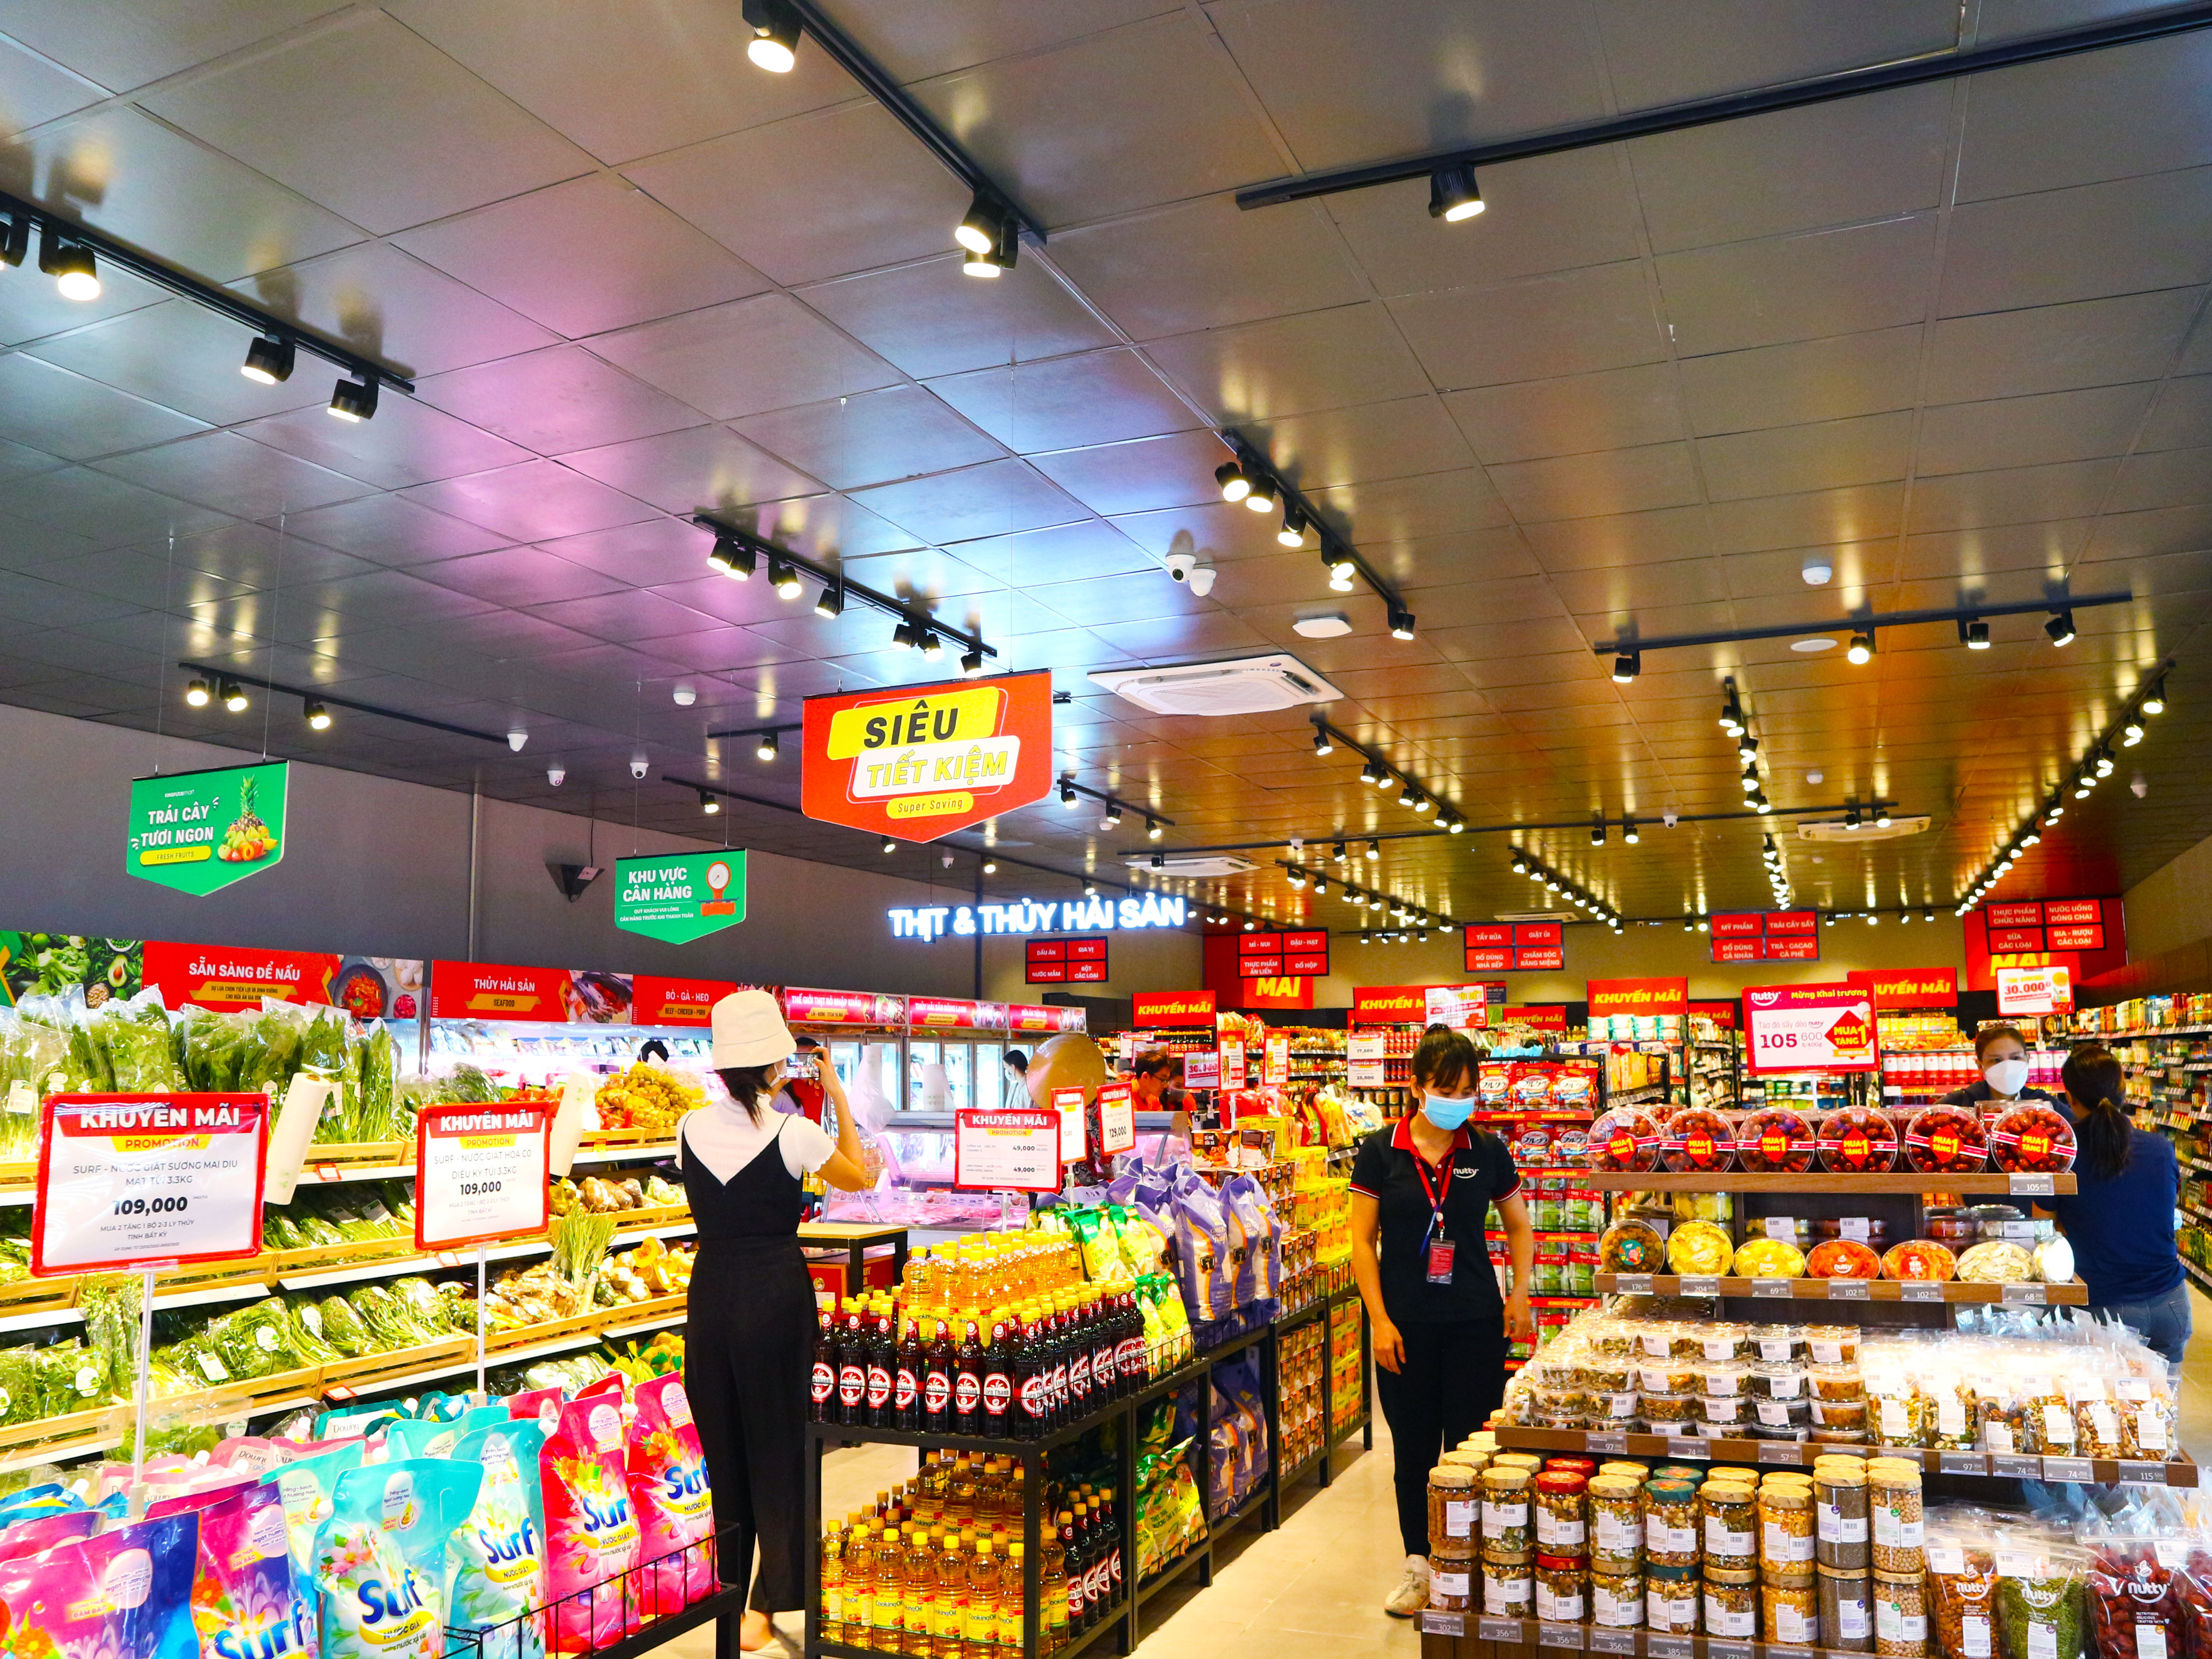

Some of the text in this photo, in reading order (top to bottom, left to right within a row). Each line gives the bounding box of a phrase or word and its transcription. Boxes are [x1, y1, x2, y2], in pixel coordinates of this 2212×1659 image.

[864, 699, 958, 748] SIÊU
[867, 745, 1008, 788] TIẾT KIỆM
[148, 801, 210, 825] TRÁI CÂY
[898, 798, 962, 814] Super Saving
[141, 827, 214, 847] TƯƠI NGON
[157, 851, 194, 861] FRESH FRUITS
[629, 866, 687, 885] KHU VỰC
[623, 882, 692, 902] CÂN HÀNG
[2072, 903, 2093, 912] UỐNG
[889, 891, 1184, 942] THỊT & THỦY HẢI SẢN
[2072, 929, 2092, 938] RƯỢU
[2075, 937, 2091, 946] LOẠI
[189, 956, 301, 980] SẴN SÀNG ĐỂ NẤU
[474, 978, 535, 992] THỦY HẢI SẢN
[666, 988, 675, 1000] BÒ
[681, 989, 690, 1000] GÀ
[696, 993, 709, 1001] HEO
[1595, 989, 1681, 1004] KHUYẾN MÃI
[1751, 992, 1779, 1006] nutty
[1837, 989, 1868, 998] trương
[493, 998, 515, 1008] SEAFOOD
[1138, 1001, 1211, 1014] KHUYẾN MÃI
[1360, 996, 1412, 1009] KHUYẾN
[1761, 1033, 1797, 1048] 105
[1834, 1025, 1866, 1045] MUA 1
[1835, 1036, 1858, 1046] TẶNG
[80, 1102, 240, 1129] KHUYẾN MÃI
[441, 1109, 533, 1132] KHUYẾN MÃI
[973, 1114, 1047, 1126] KHUYẾN MÃI
[1109, 1125, 1126, 1138] 129,000
[126, 1138, 199, 1148] PROMOTION
[467, 1138, 509, 1146] PROMOTION
[1706, 1140, 1711, 1154] 1
[1844, 1140, 1868, 1154] MUA 1
[73, 1165, 101, 1174] SURF
[168, 1162, 201, 1170] SƯƠNG
[223, 1160, 238, 1169] DỊU
[1454, 1168, 1478, 1178] nutty
[168, 1176, 192, 1184] 3.3KG
[460, 1181, 501, 1196] 109,000
[114, 1197, 188, 1216] 109,000
[1963, 1463, 1972, 1471] 97
[2017, 1467, 2026, 1475] 74
[2068, 1470, 2078, 1479] 74
[479, 1517, 534, 1564] Surf
[504, 1569, 518, 1578] NƯỚC
[1956, 1582, 1990, 1600] nutty
[2128, 1582, 2167, 1603] nutty
